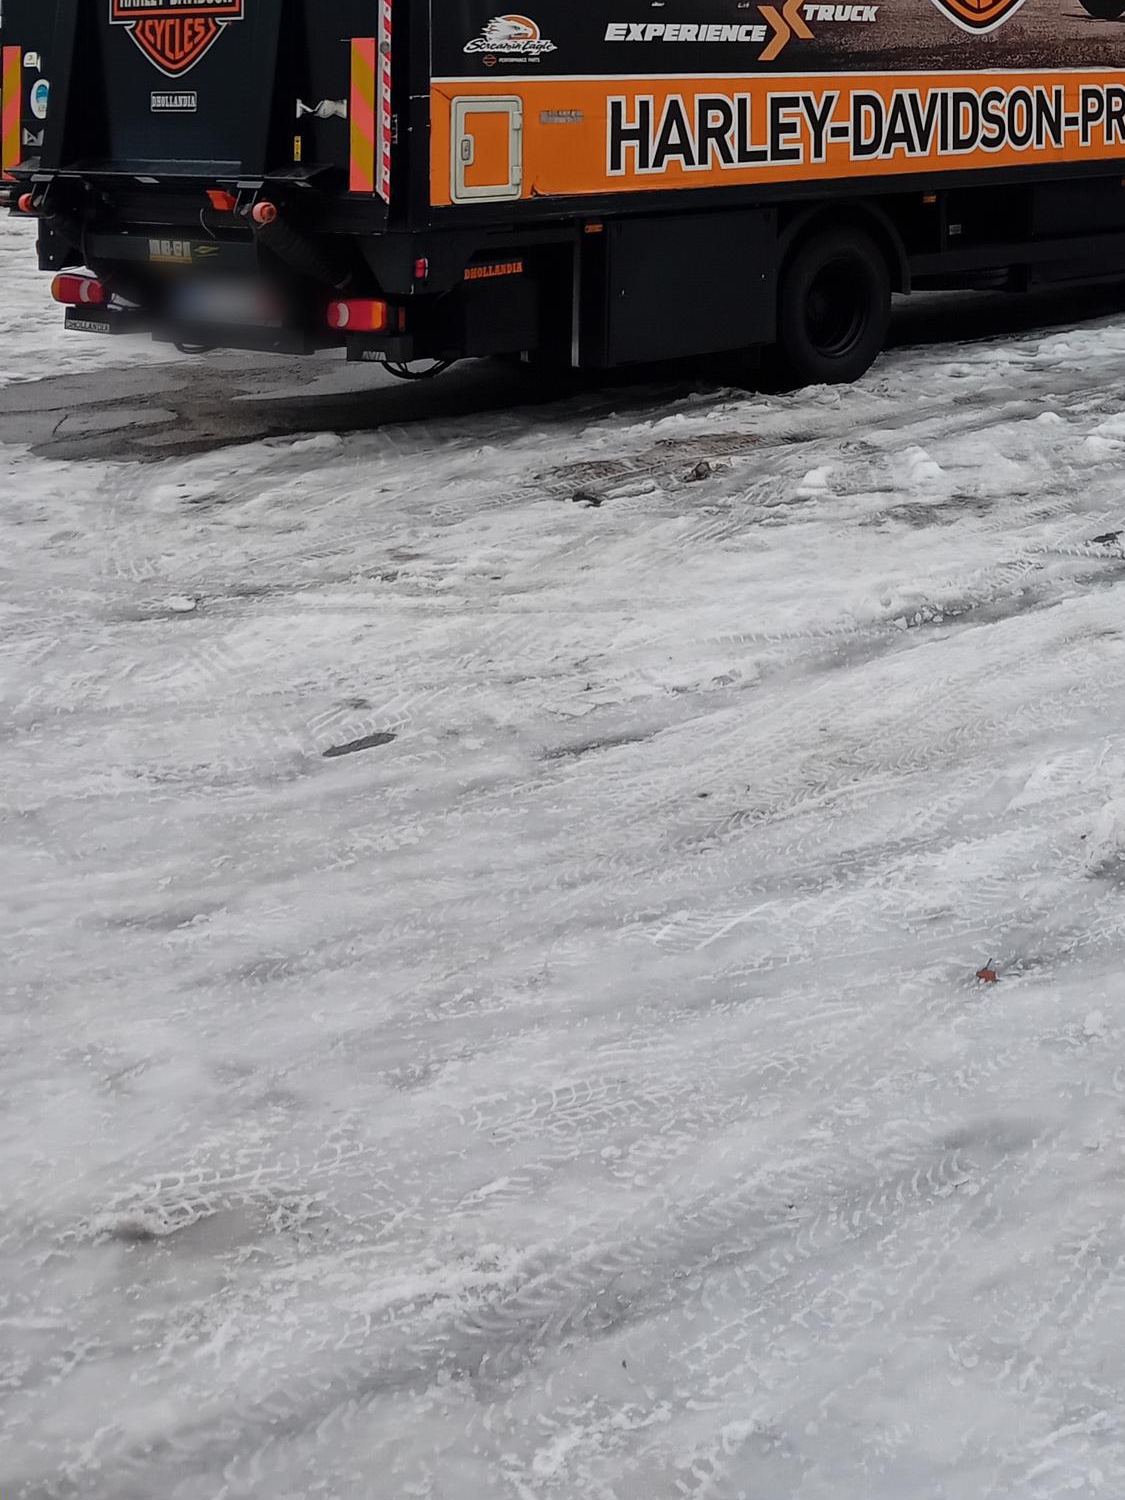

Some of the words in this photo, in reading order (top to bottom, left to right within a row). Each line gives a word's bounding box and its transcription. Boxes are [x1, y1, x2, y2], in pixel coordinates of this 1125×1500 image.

[604, 23, 768, 42] EXPERIENCE
[803, 4, 879, 22] TRUCK
[144, 17, 206, 61] CYCLES
[152, 95, 197, 108] DHOLLANDIA
[464, 261, 523, 280] DHOLLANDIA
